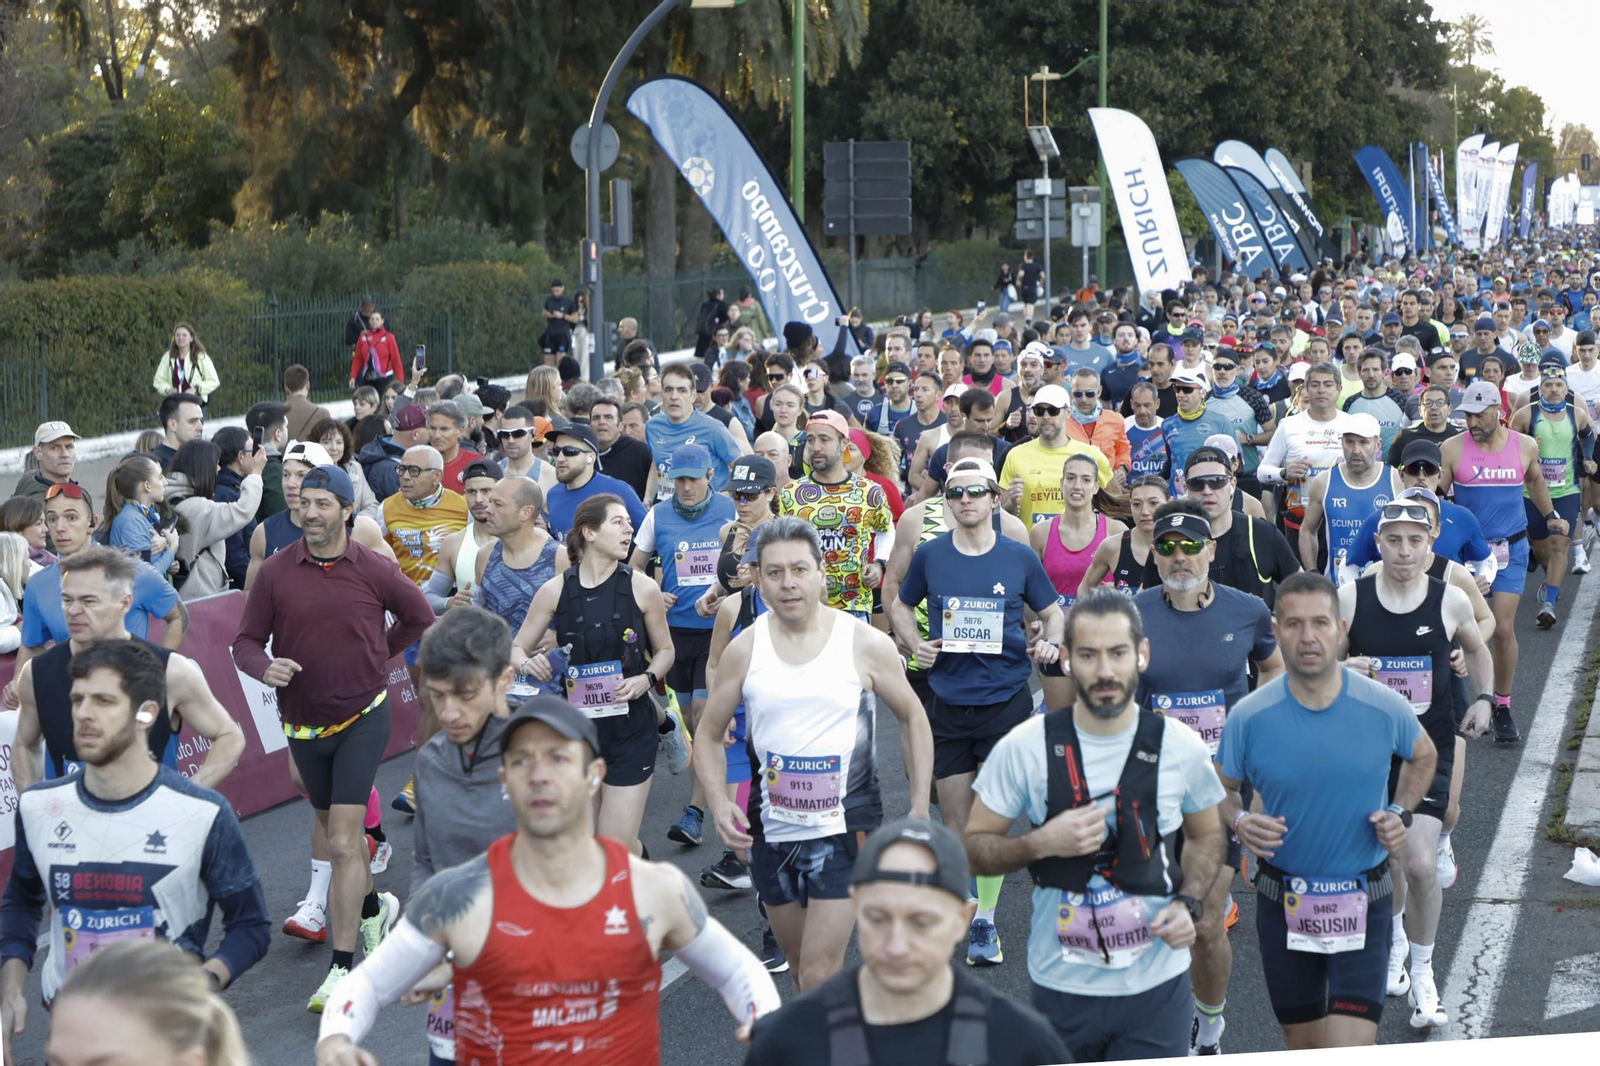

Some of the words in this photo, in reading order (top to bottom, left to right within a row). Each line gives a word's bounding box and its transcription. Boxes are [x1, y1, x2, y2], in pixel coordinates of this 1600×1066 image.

[1030, 492, 1064, 502] SEVIL
[1331, 519, 1364, 527] SCUNTH
[818, 528, 843, 538] pace
[691, 541, 719, 549] ZURICH
[1340, 538, 1354, 546] DIS
[690, 564, 713, 575] MIKE
[963, 600, 997, 610] ZURICH
[964, 616, 982, 625] 5876
[953, 627, 991, 640] OSCAR
[1386, 660, 1424, 669] ZURICH
[388, 665, 410, 686] nstitut
[582, 665, 615, 676] ZURICH
[585, 682, 604, 692] 9639
[1387, 677, 1408, 686] 8706
[582, 692, 612, 706] JULIE
[1176, 695, 1216, 707] ZURICH
[788, 760, 831, 771] ZURICH
[790, 780, 813, 791] 9113
[769, 792, 839, 810] BIOCLIMATICO
[54, 872, 71, 889] 58
[73, 872, 144, 892] BEHOBIA
[1312, 881, 1357, 893] ZURICH
[1088, 888, 1124, 906] URIC
[1313, 904, 1338, 915] 9462
[86, 913, 142, 930] ZURICH
[1297, 917, 1358, 934] JESUSIN
[1058, 934, 1094, 949] PEPE
[1097, 926, 1151, 949] UERTA
[426, 1012, 454, 1035] PAP
